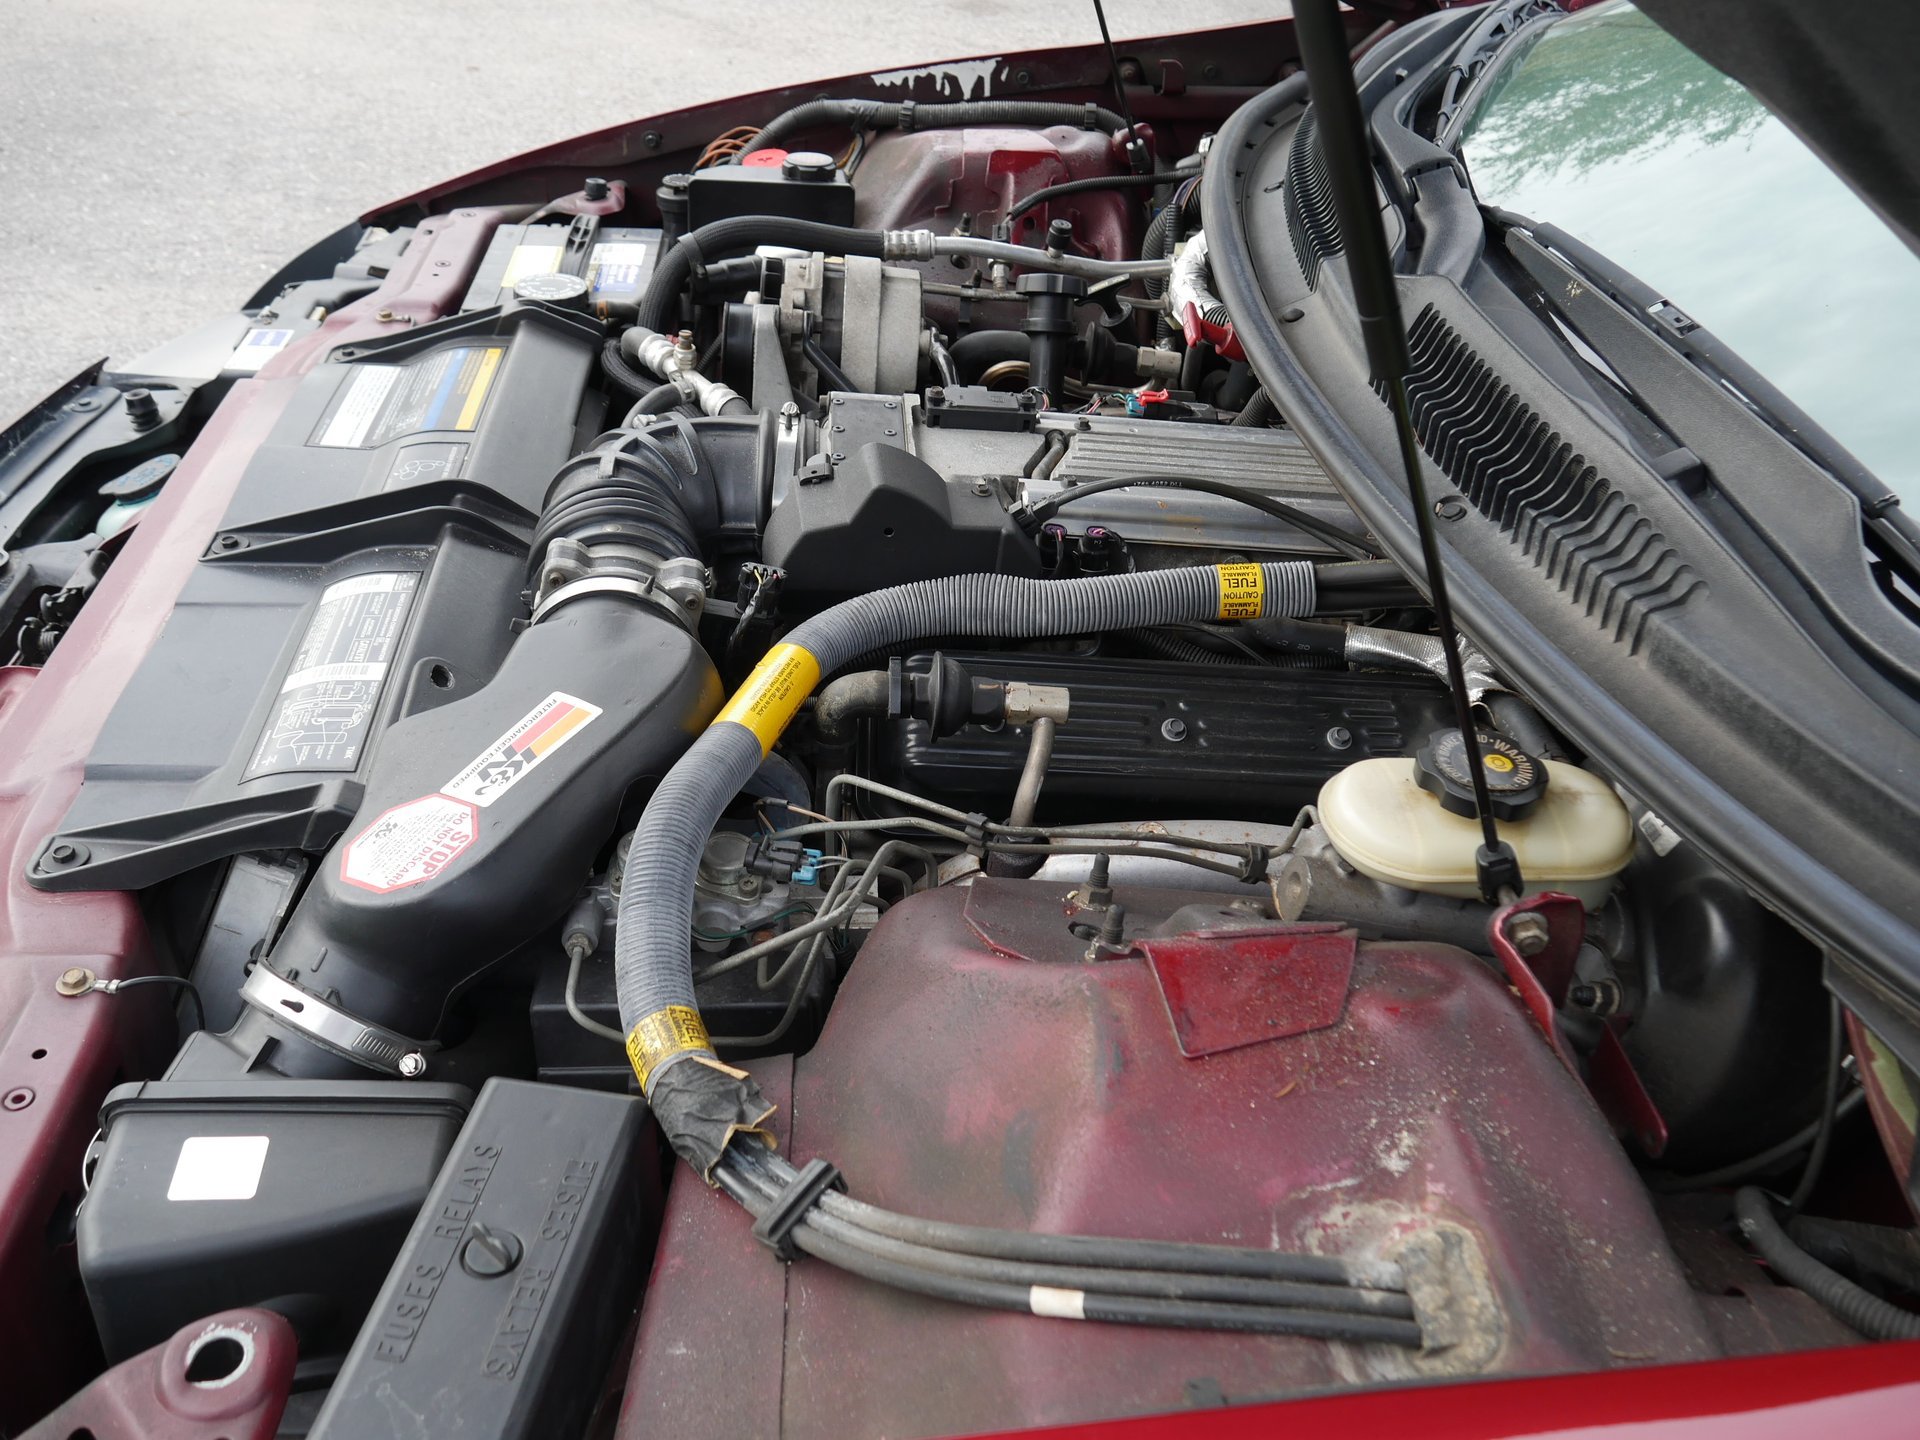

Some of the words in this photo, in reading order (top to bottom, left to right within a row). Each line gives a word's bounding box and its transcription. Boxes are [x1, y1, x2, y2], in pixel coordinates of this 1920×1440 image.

[1224, 578, 1257, 588] FUEL
[1224, 591, 1258, 599] CAUTION
[452, 753, 494, 789] EQUIPPED
[1494, 740, 1534, 785] WARNING
[432, 826, 454, 846] NOT
[453, 812, 469, 825] DO
[387, 846, 432, 886] DISCARD
[422, 831, 469, 874] STOP
[679, 1011, 702, 1042] FUEL
[630, 1035, 646, 1075] FUEL
[542, 1159, 598, 1242] FUSES
[374, 1264, 443, 1364] FUSES
[434, 1144, 501, 1240] RELAIS
[484, 1268, 552, 1382] RELAYS
